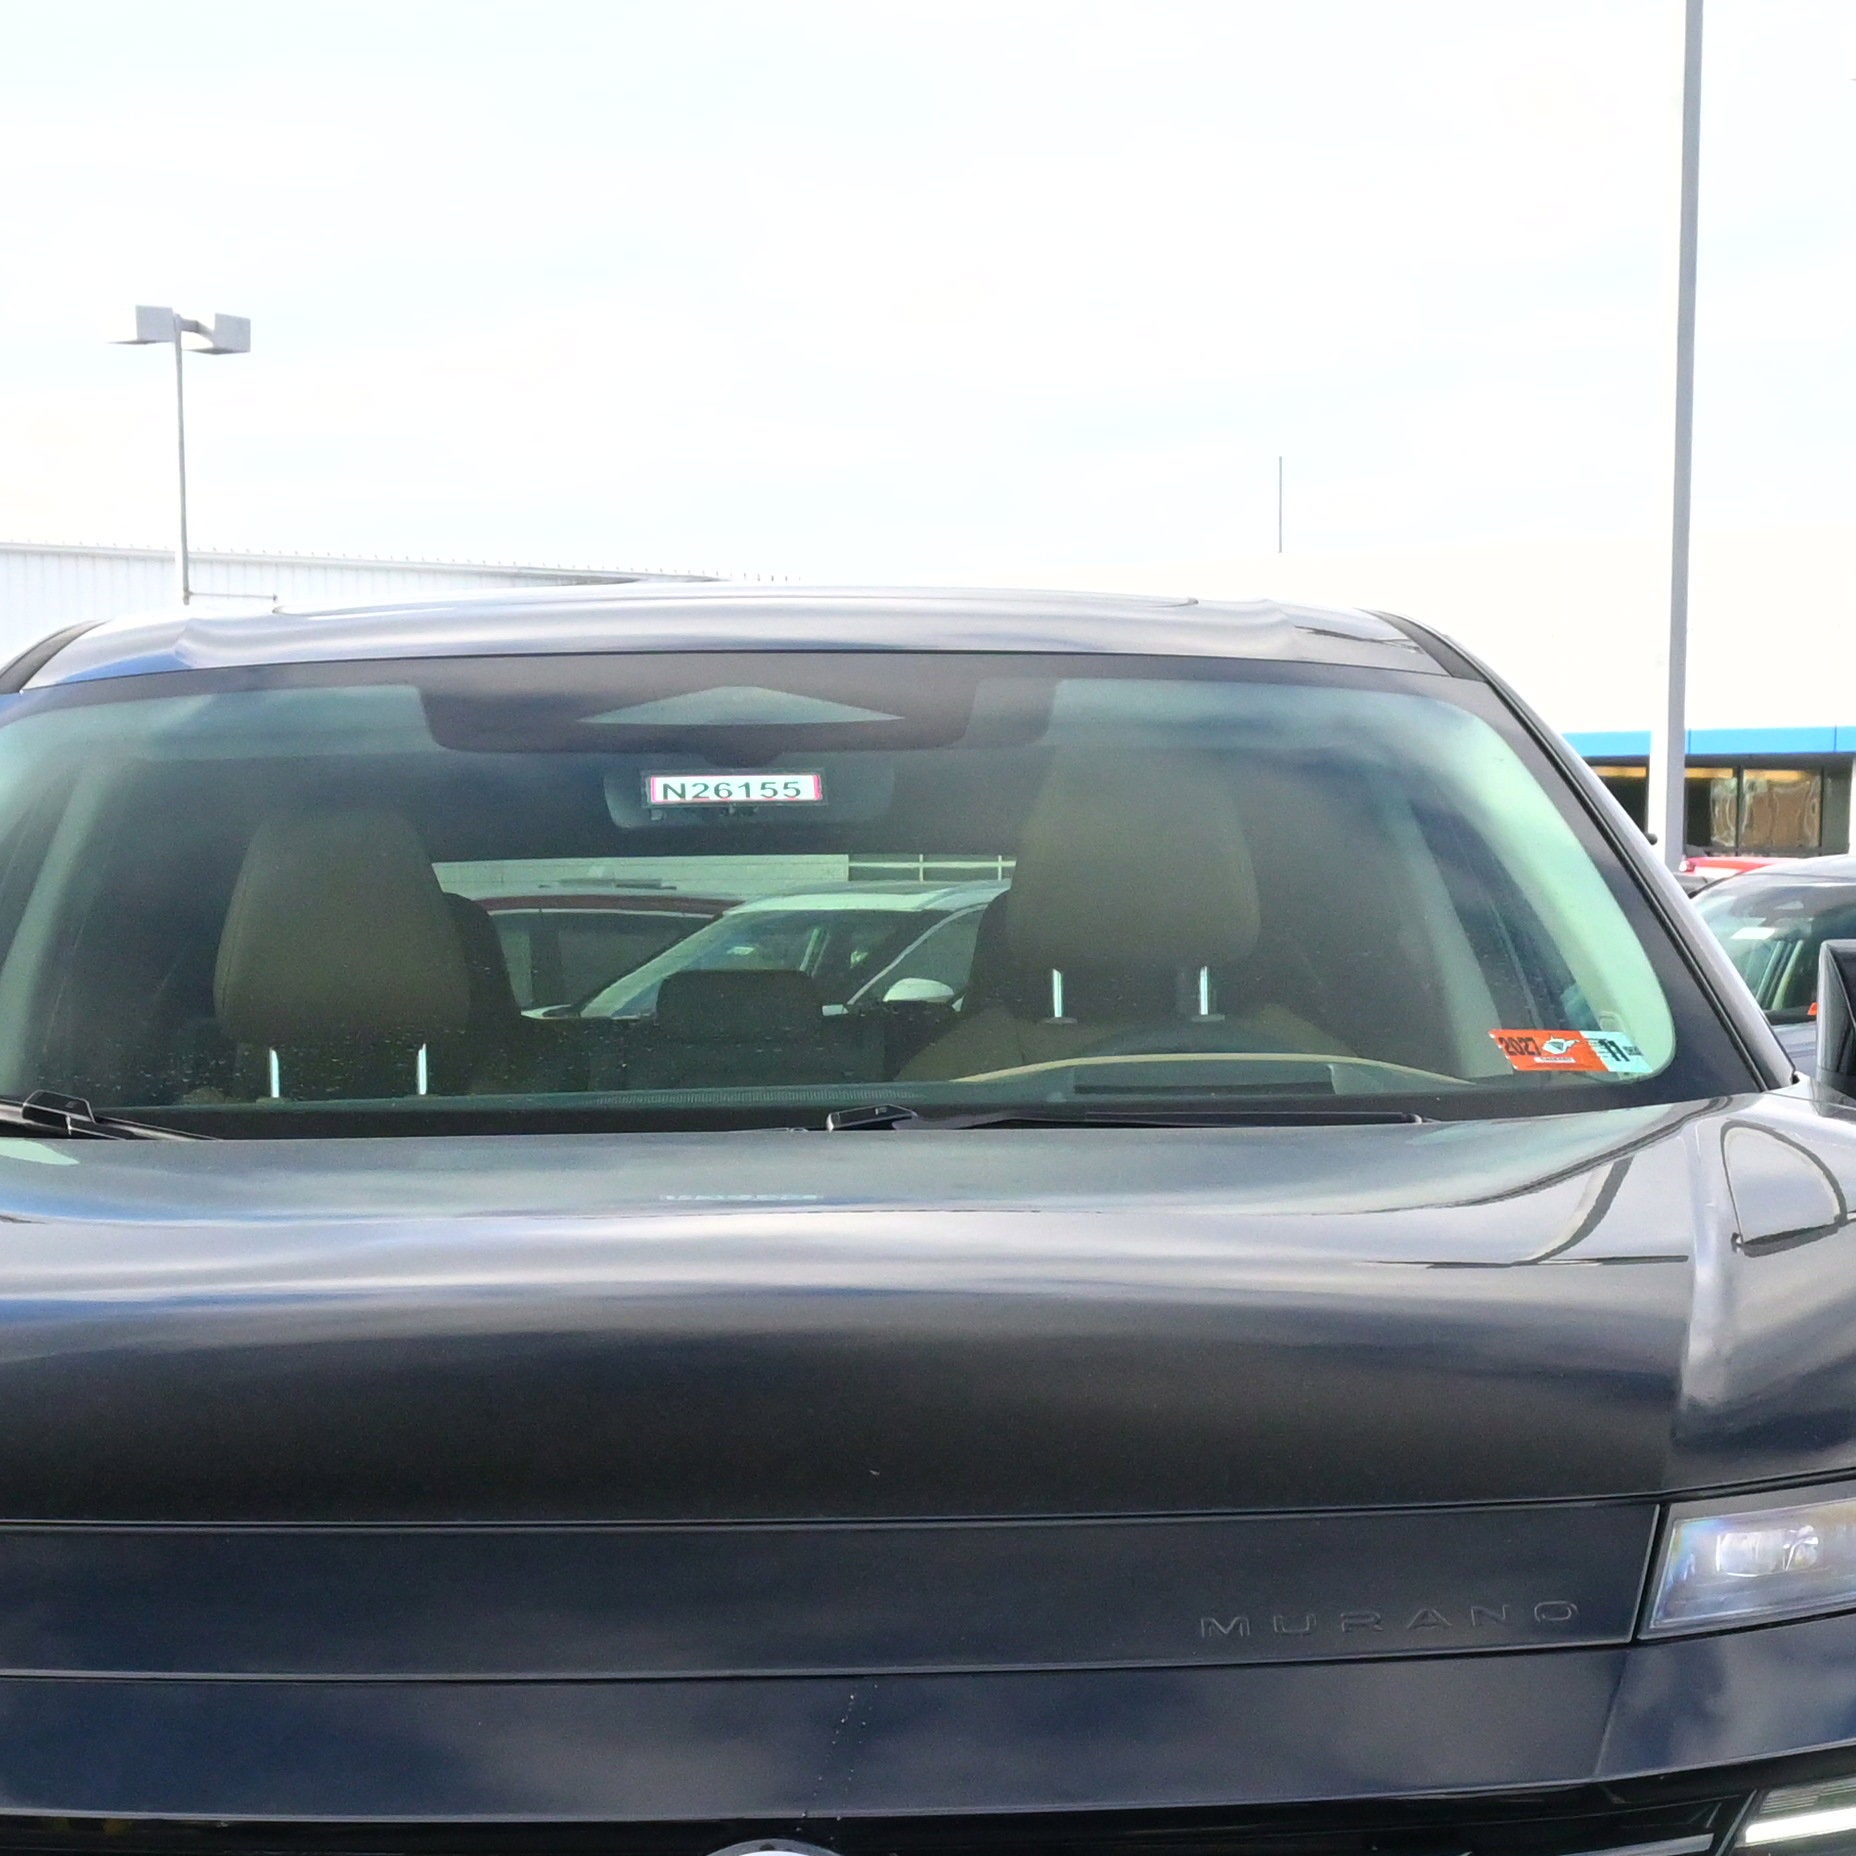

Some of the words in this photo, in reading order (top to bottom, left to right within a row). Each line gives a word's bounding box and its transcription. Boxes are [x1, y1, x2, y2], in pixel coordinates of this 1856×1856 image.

[662, 781, 802, 801] N26155
[1498, 1036, 1542, 1057] 2027
[1598, 1038, 1630, 1063] 11
[1200, 1600, 1579, 1638] MURANO
